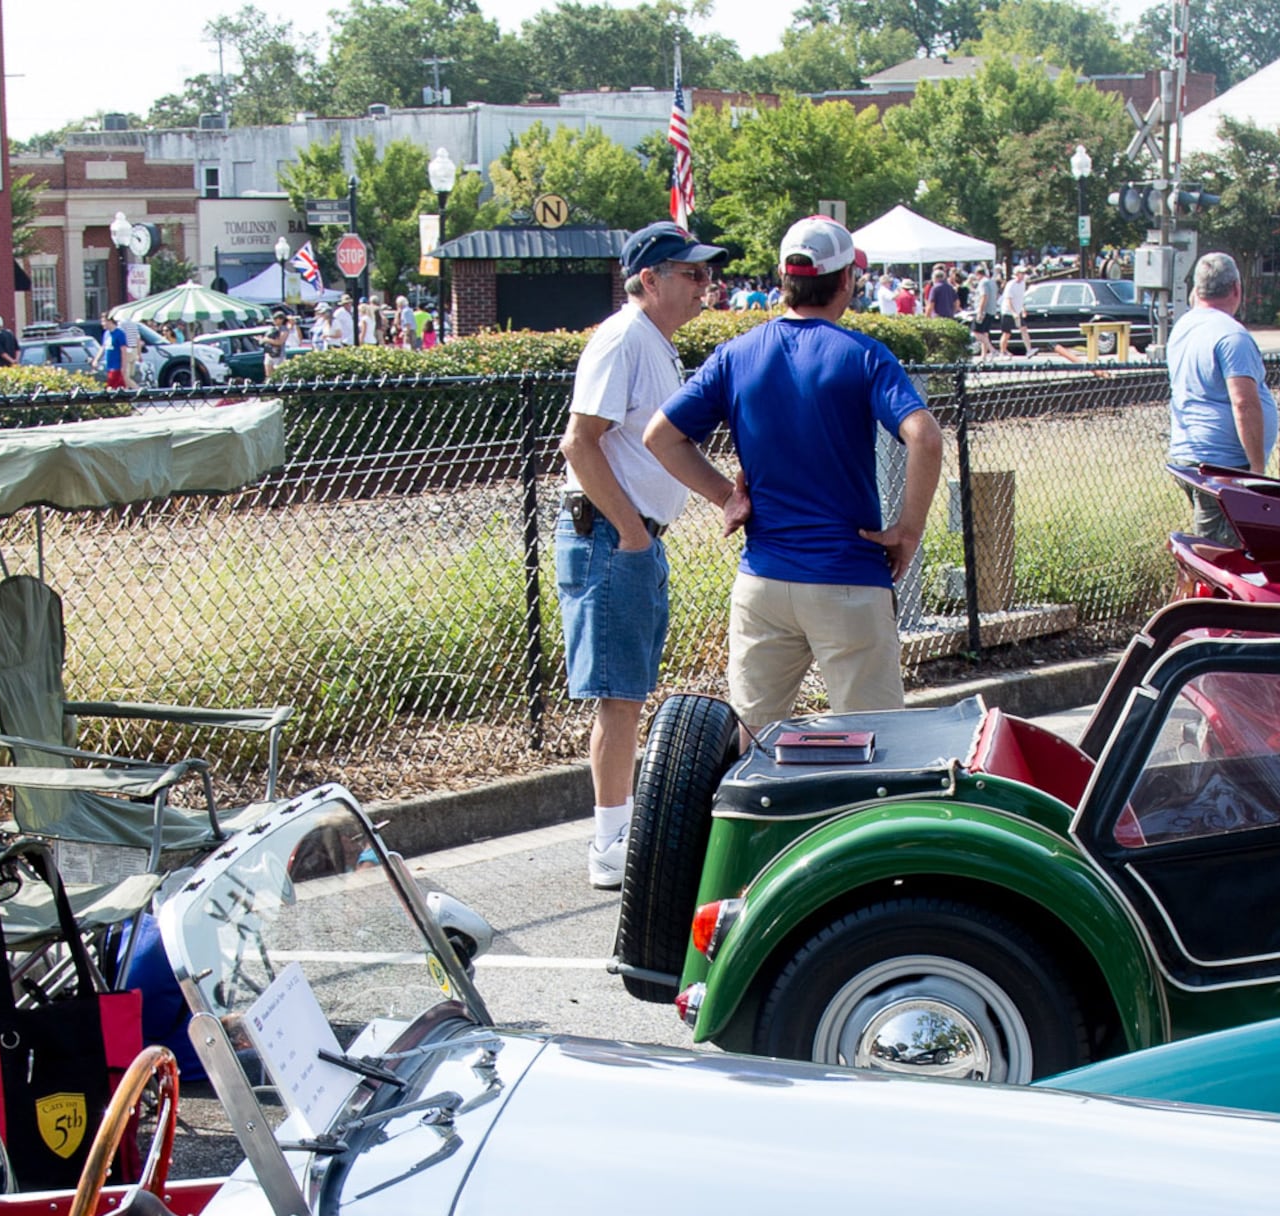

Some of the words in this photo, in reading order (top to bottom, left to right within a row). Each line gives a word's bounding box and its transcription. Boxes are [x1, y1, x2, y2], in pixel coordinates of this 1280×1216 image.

[542, 200, 561, 222] N
[224, 220, 277, 234] TOMLINSON
[230, 235, 246, 245] LAW
[247, 234, 270, 245] OFFICE
[338, 248, 364, 264] STOP
[55, 1108, 83, 1150] 5th
